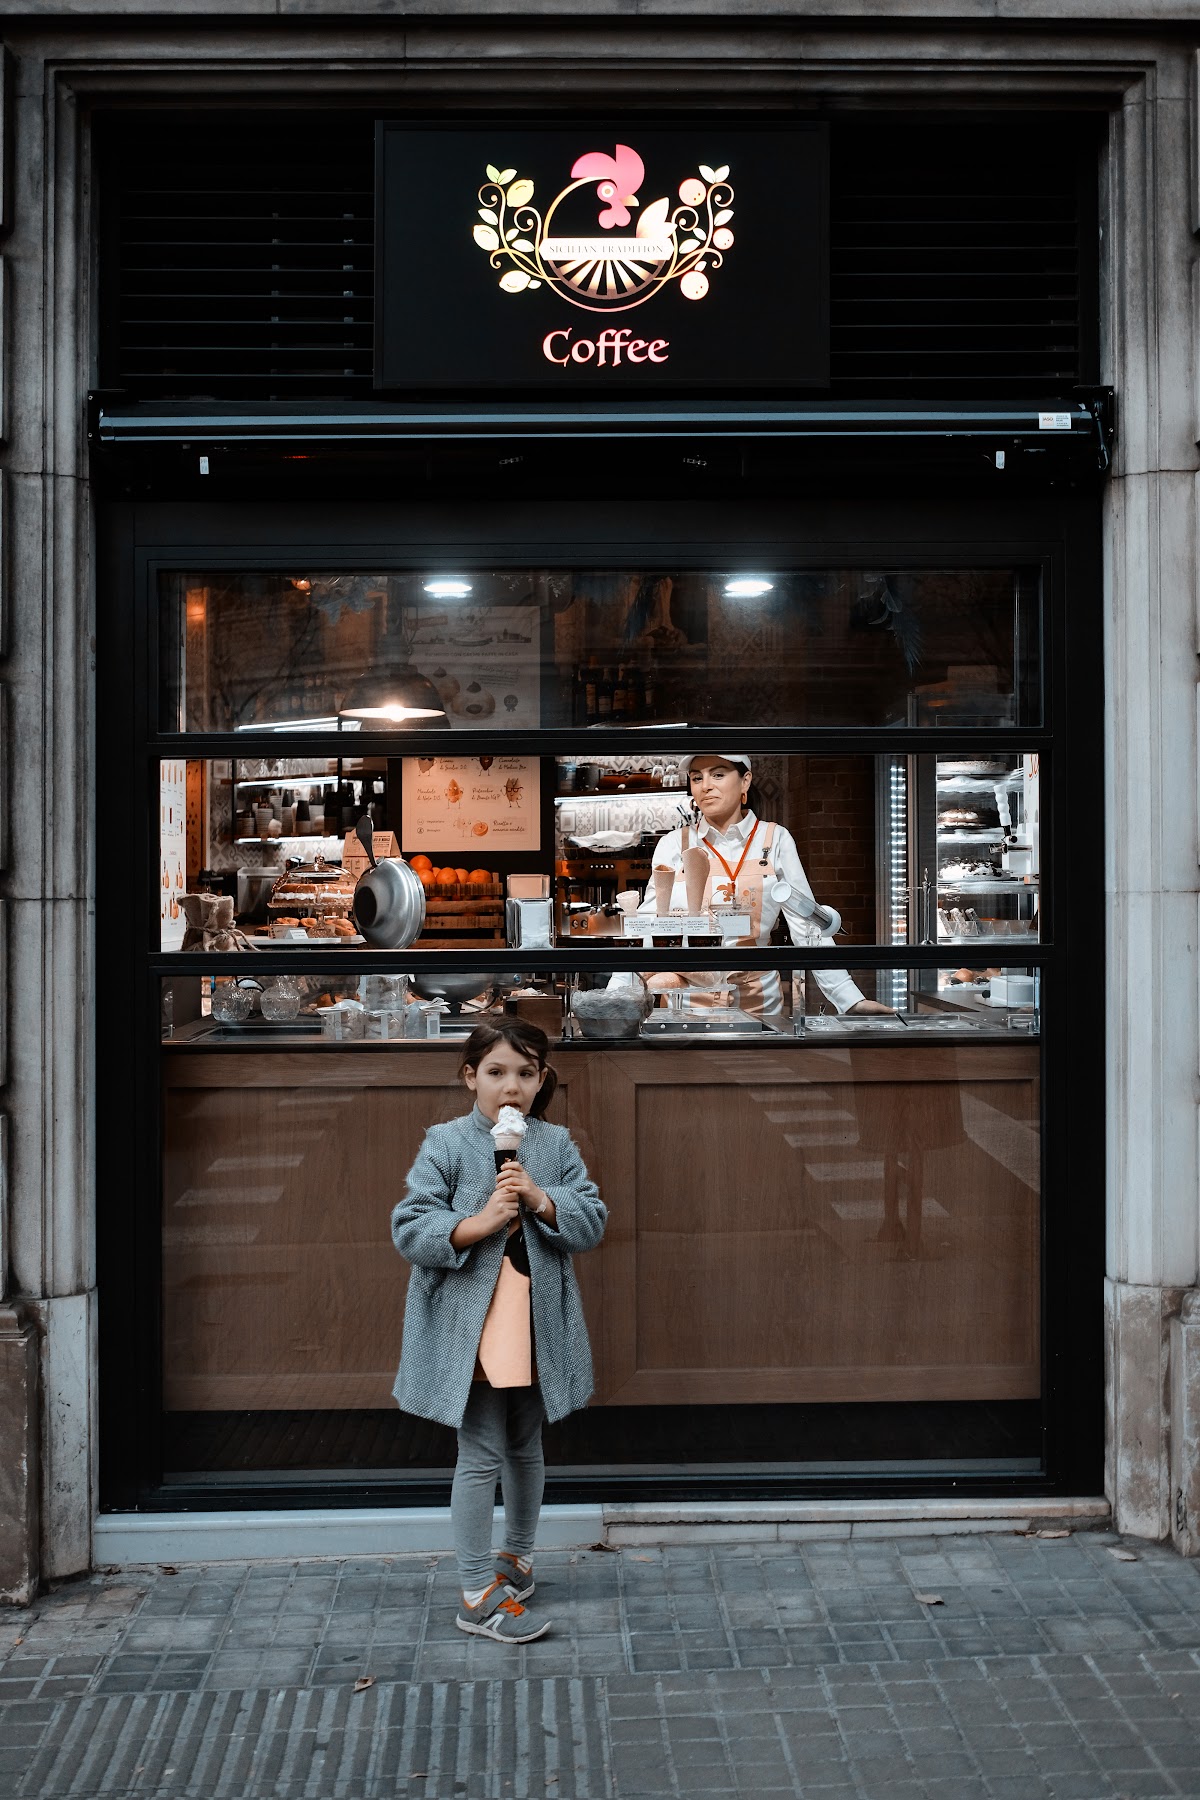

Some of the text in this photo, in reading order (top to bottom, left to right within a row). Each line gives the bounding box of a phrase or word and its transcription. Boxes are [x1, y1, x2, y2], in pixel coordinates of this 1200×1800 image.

[549, 245, 664, 254] SICILIAN TRADITION
[542, 327, 670, 368] Coffee
